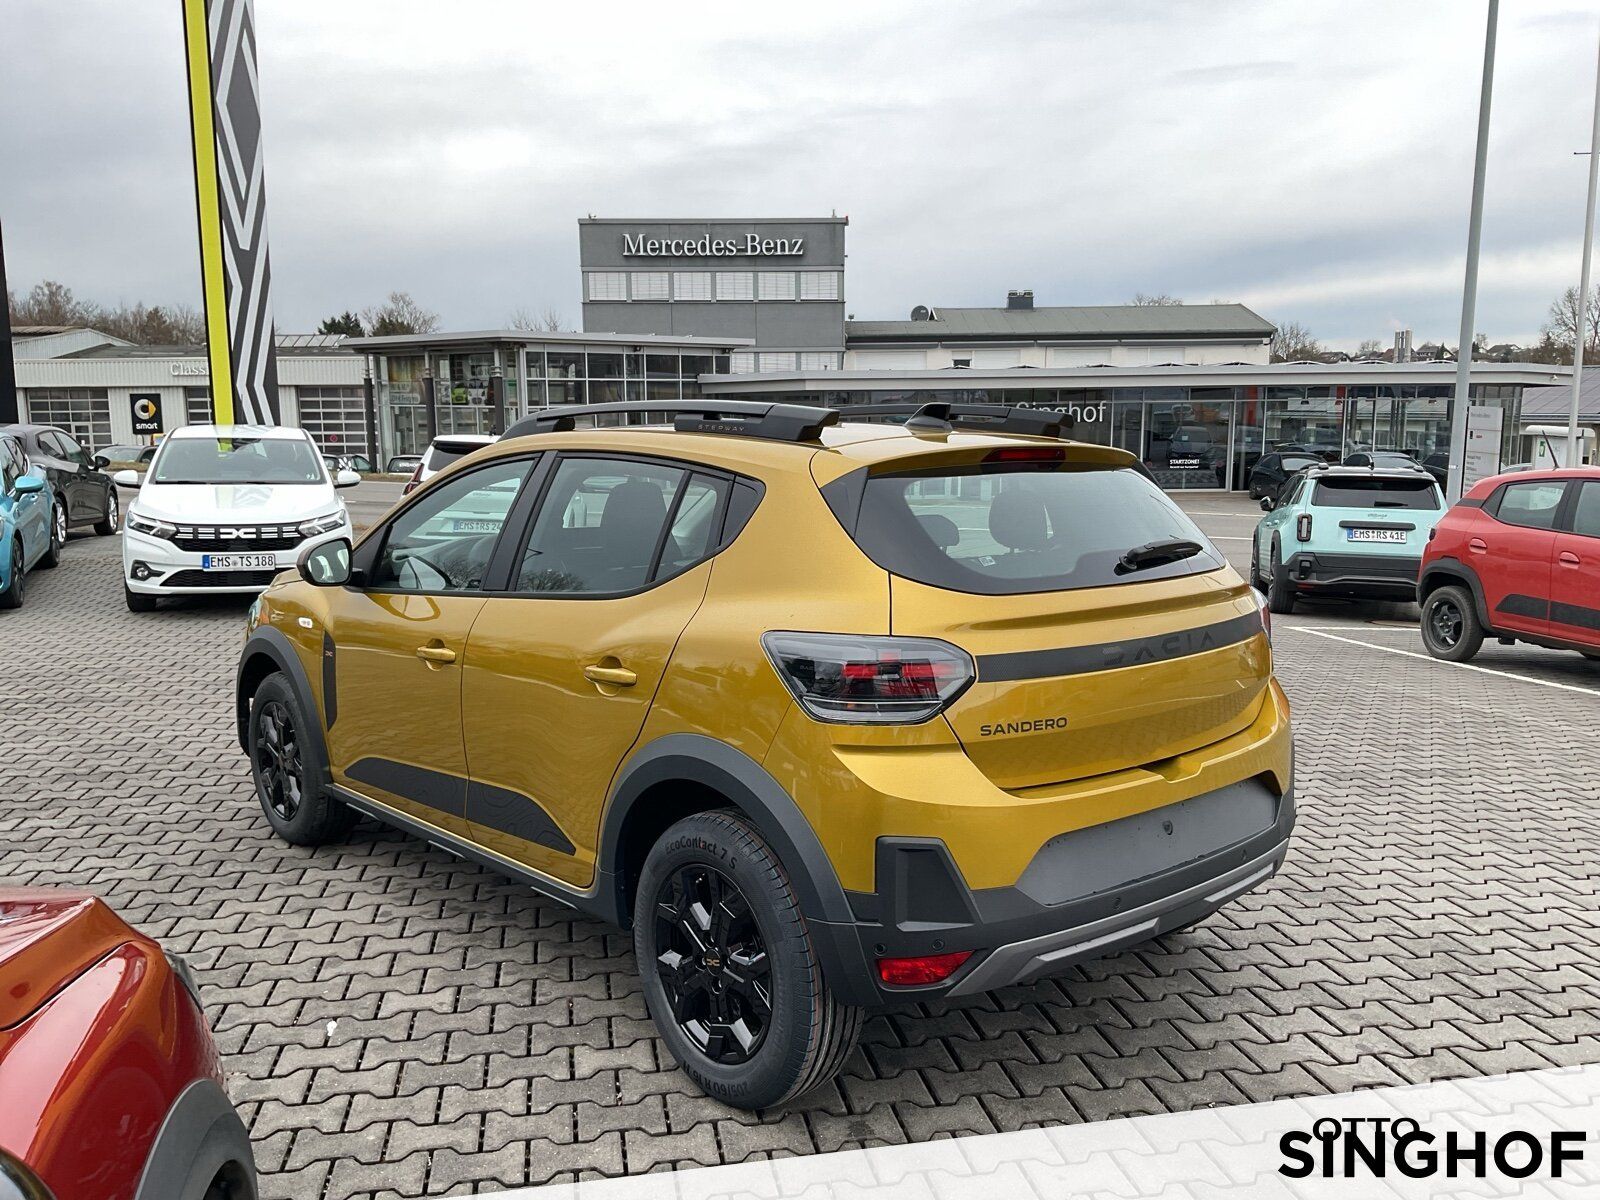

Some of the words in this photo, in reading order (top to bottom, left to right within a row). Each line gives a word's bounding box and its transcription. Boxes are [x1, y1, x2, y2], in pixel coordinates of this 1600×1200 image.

[622, 233, 804, 257] Mercedes-Benz
[135, 422, 158, 430] smart
[459, 520, 474, 530] EMS
[479, 521, 490, 531] RS
[1353, 530, 1370, 539] EMS
[1376, 531, 1388, 540] RS
[1389, 531, 1406, 541] 41E
[210, 556, 231, 568] EMS
[238, 556, 252, 567] TS
[254, 555, 274, 567] 188
[1102, 630, 1216, 666] DACIA
[980, 716, 1068, 736] SANDERO
[665, 835, 717, 855] EcoContact
[720, 847, 728, 860] 7
[728, 856, 738, 870] S
